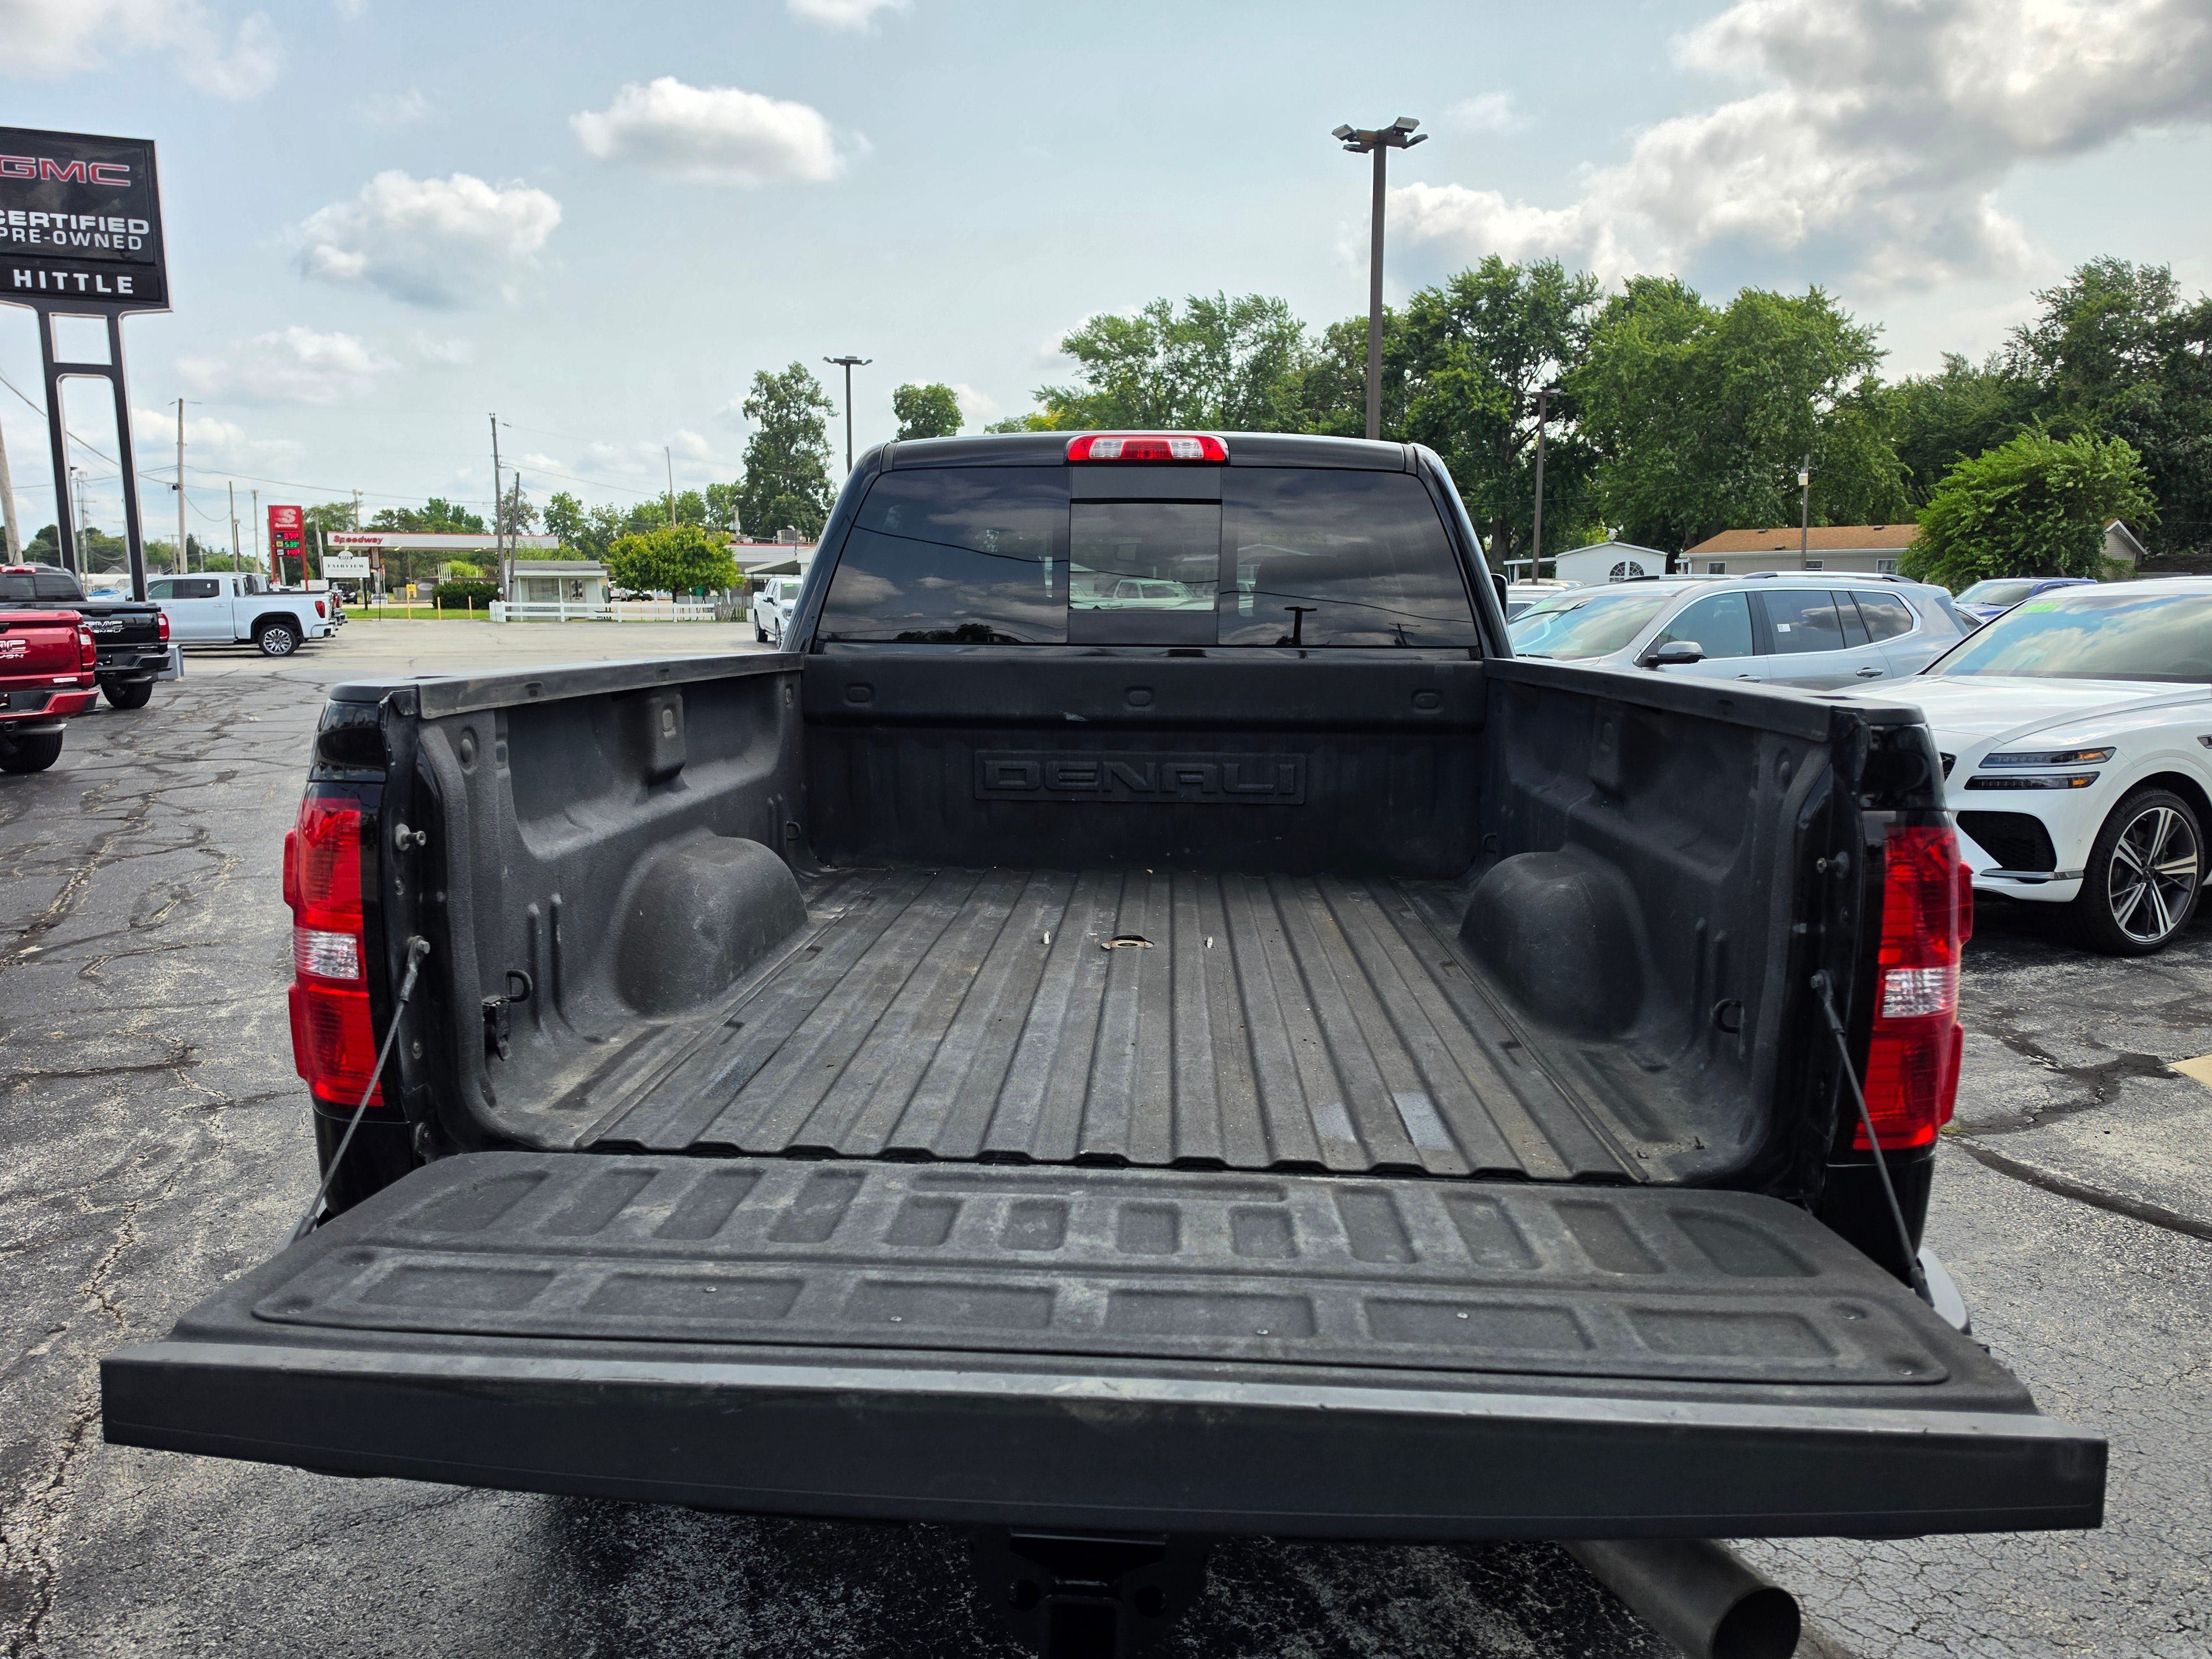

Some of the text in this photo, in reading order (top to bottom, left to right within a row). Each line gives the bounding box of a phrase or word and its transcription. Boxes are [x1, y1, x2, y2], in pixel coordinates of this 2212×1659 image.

[0, 154, 131, 186] GMC
[13, 269, 133, 294] HITTLE
[333, 535, 383, 545] Speedway
[984, 760, 1295, 795] DENALI
